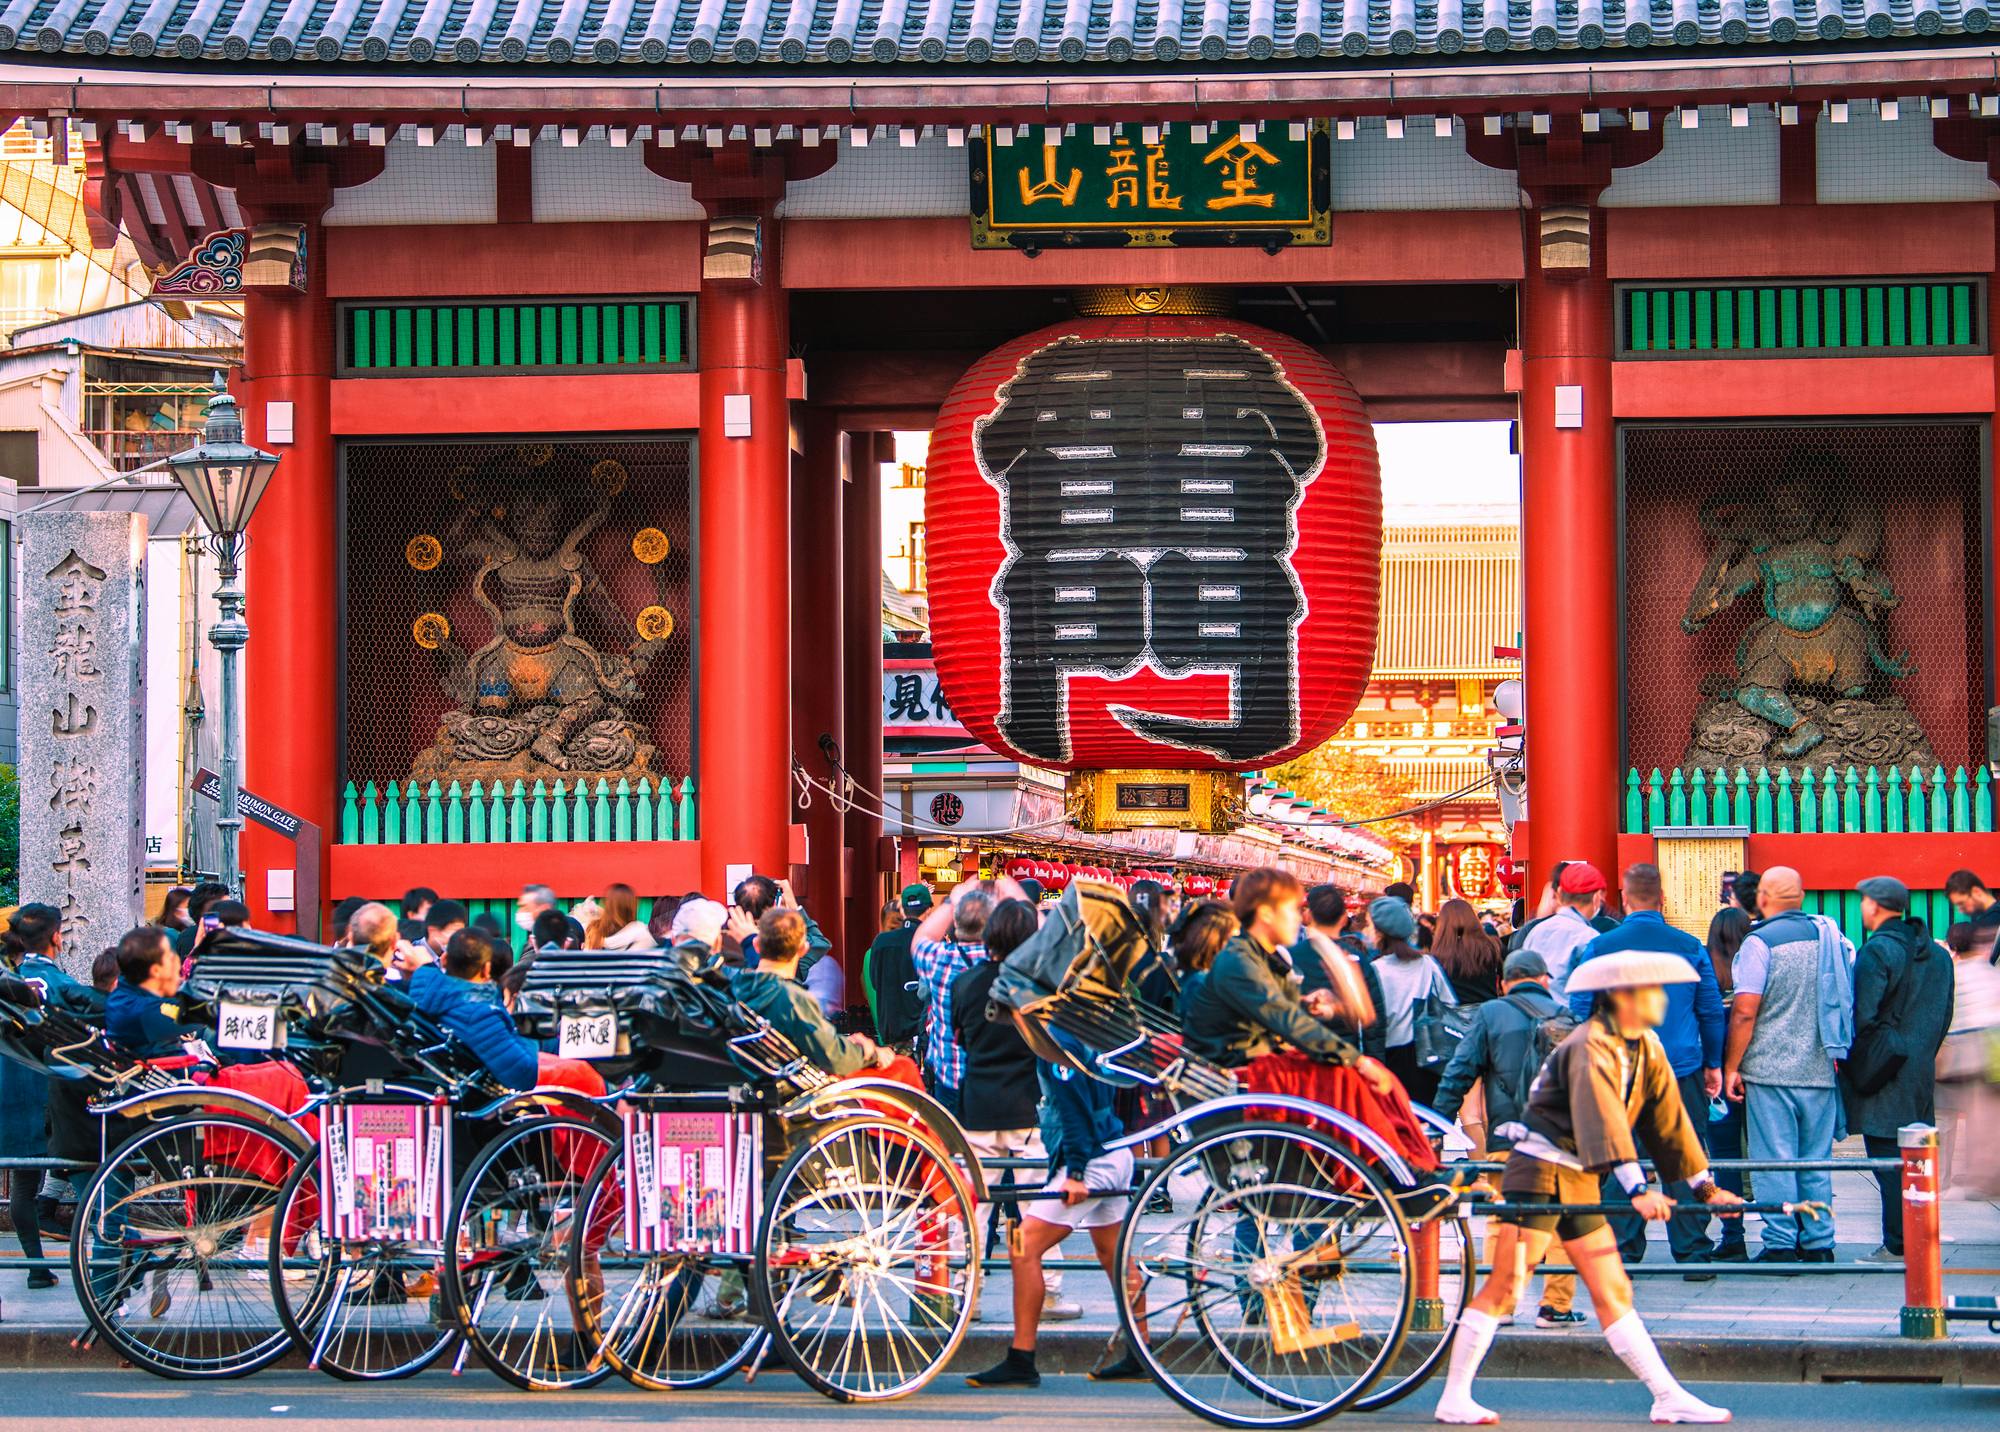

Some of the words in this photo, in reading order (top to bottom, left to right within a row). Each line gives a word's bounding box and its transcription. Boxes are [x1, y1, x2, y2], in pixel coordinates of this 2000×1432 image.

[971, 333, 1328, 764] 雷門
[1121, 788, 1185, 805] 松下電器
[272, 811, 298, 828] GATE
[145, 836, 162, 853] 店
[224, 1014, 268, 1041] 時代屋
[565, 1018, 610, 1047] 時代屋
